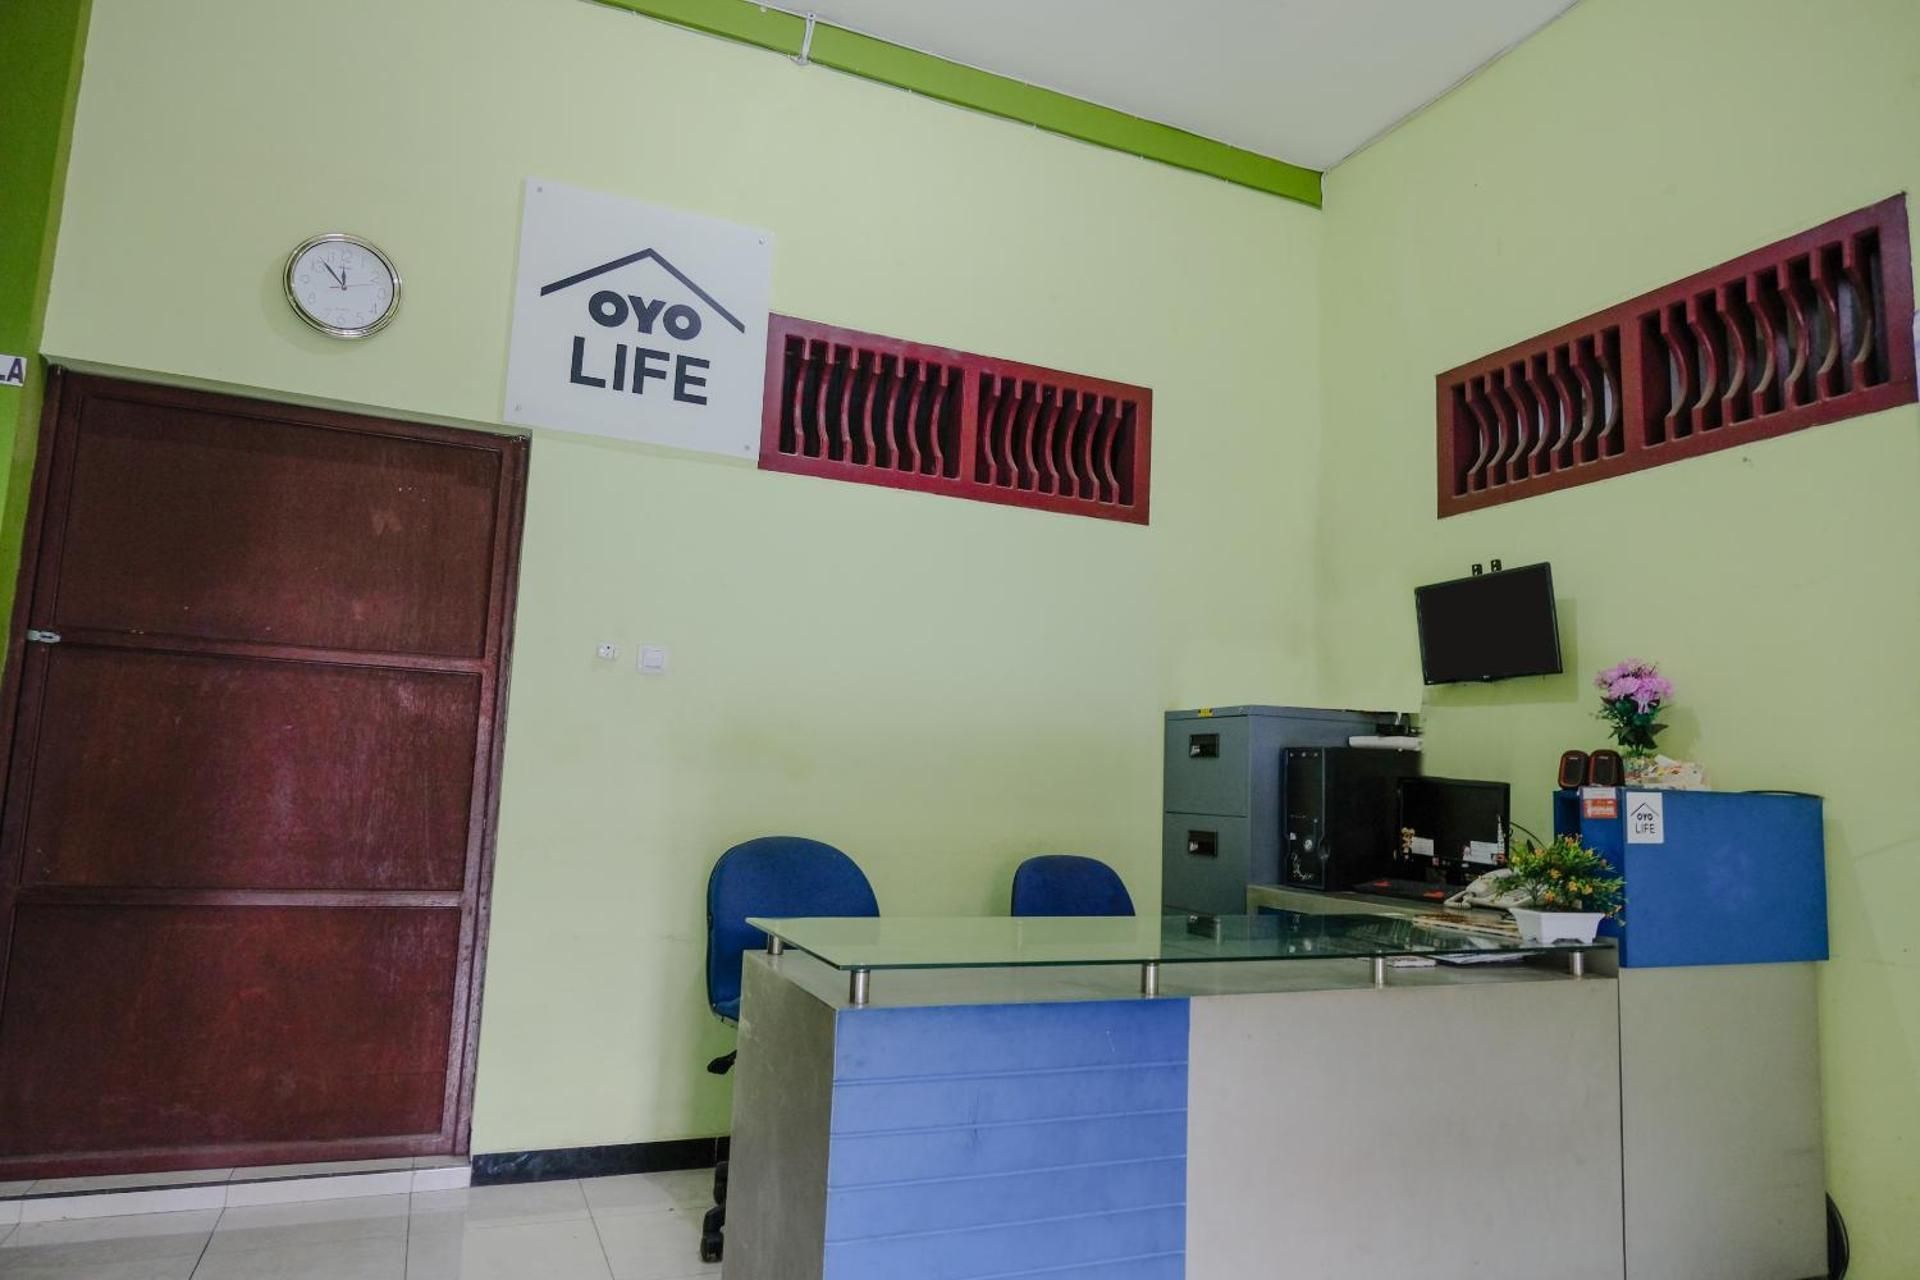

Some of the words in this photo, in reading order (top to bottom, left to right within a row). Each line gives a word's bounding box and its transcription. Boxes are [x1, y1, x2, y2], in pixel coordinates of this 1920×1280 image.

[341, 248, 353, 263] 12
[588, 290, 702, 341] OYO
[570, 335, 710, 405] LIFE
[1636, 812, 1654, 821] OYO
[1635, 823, 1656, 834] LIFE
